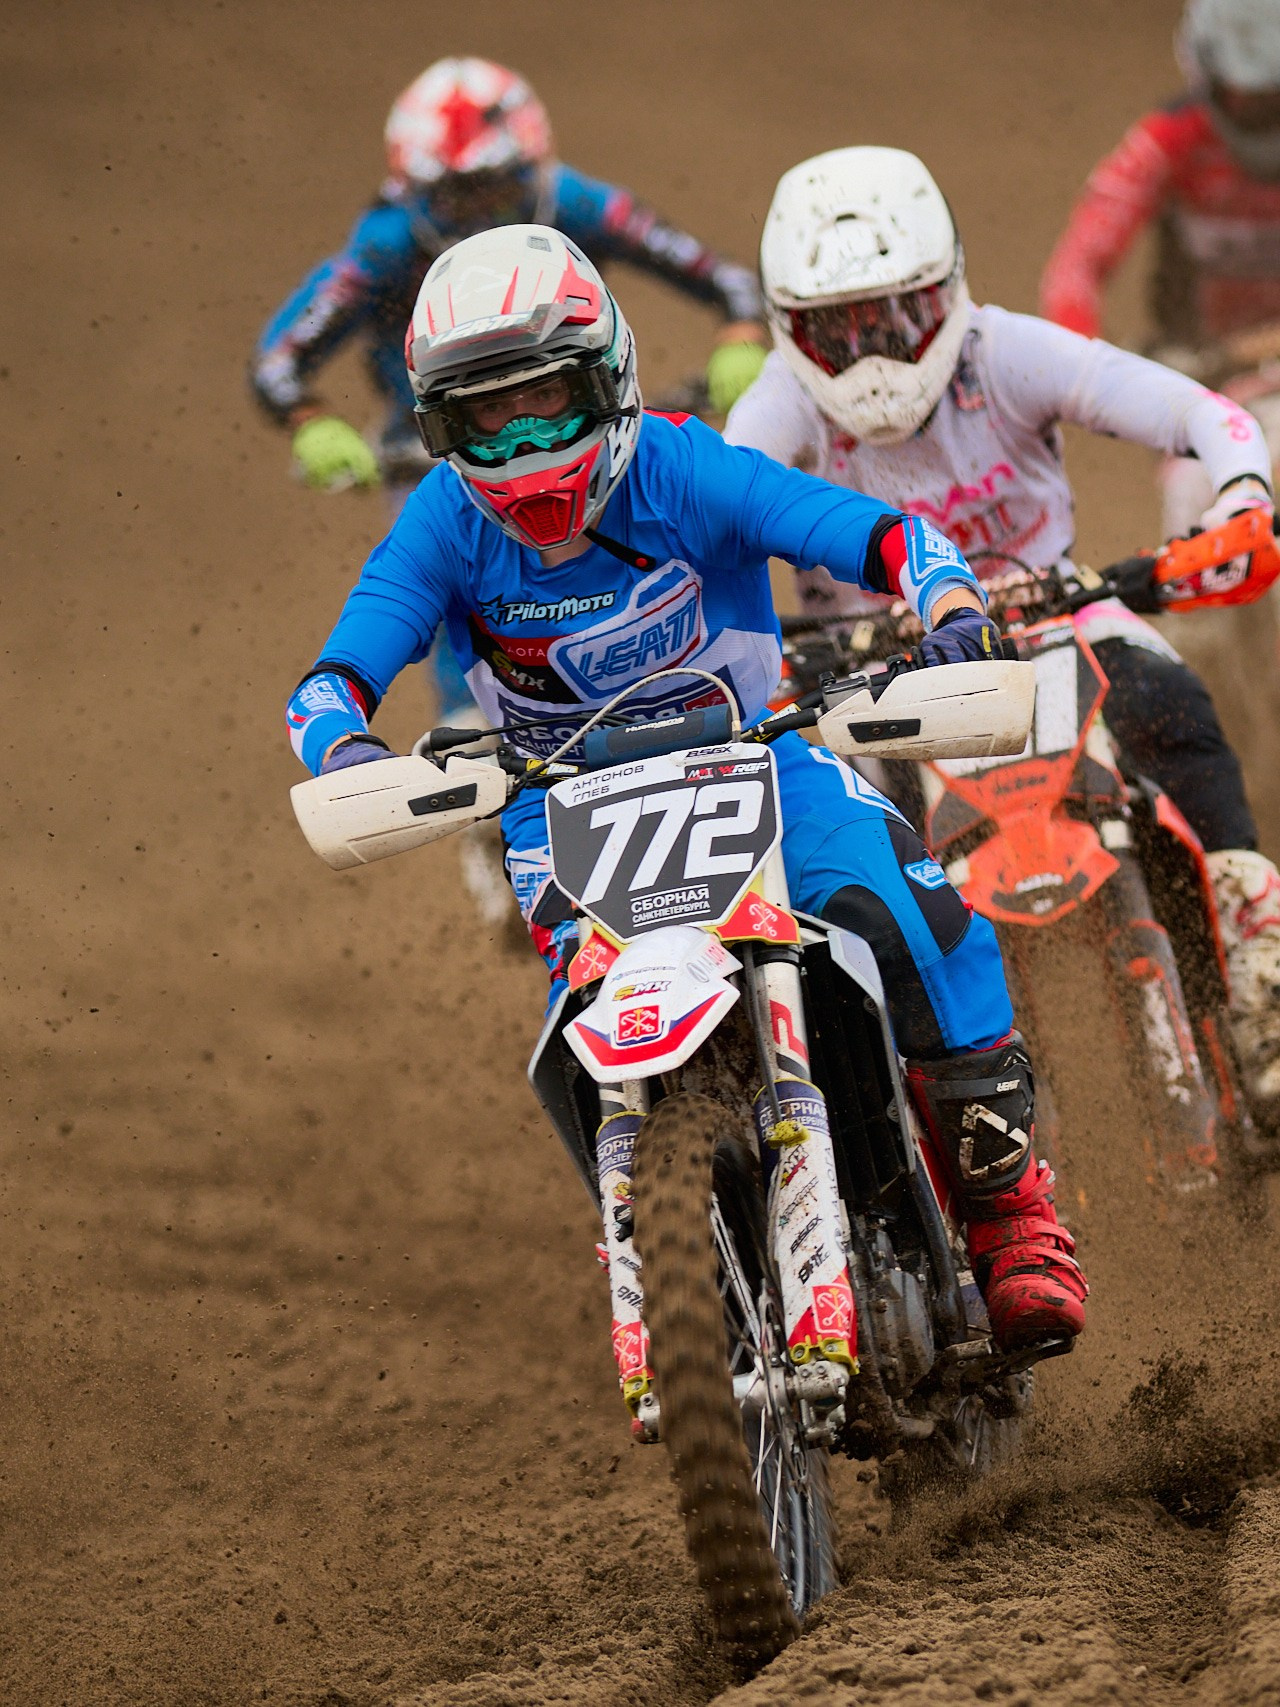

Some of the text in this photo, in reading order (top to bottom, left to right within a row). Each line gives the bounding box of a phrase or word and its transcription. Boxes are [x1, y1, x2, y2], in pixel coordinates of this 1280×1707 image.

[571, 765, 644, 791] АНТОНОВ
[573, 785, 610, 802] ГЛЕБ
[581, 780, 764, 906] 772
[631, 888, 710, 913] СБОРНАЯ
